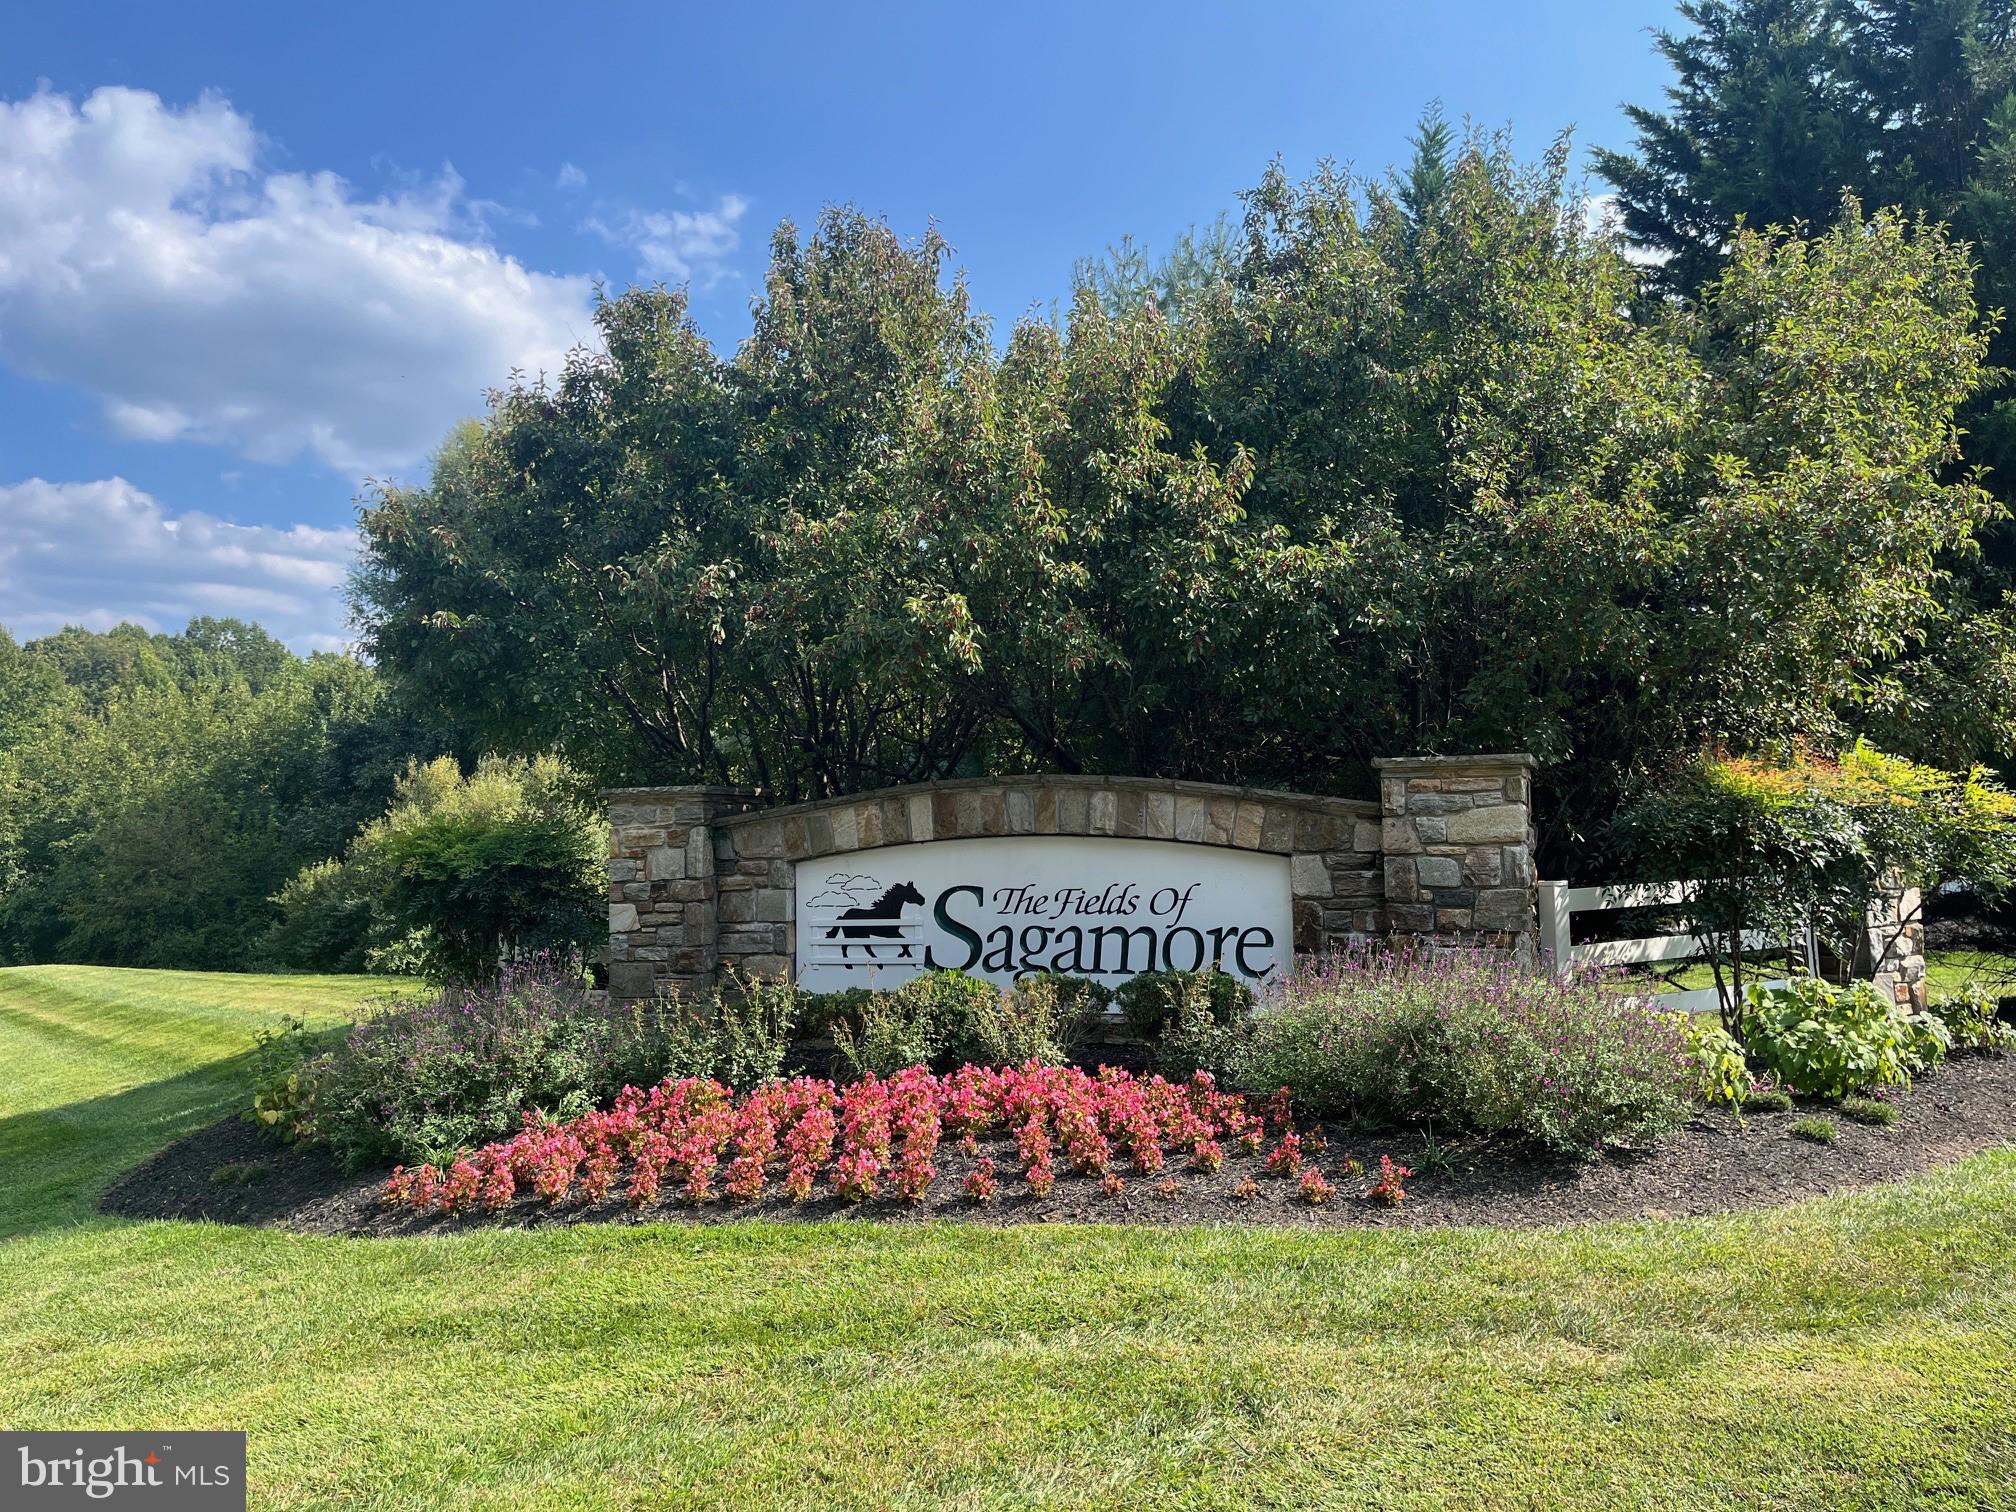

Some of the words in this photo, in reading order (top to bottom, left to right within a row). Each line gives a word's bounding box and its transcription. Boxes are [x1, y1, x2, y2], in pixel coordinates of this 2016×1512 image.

[924, 885, 1276, 985] Sagamore
[992, 883, 1048, 915] The
[1048, 883, 1140, 920] Fields
[1149, 883, 1202, 929] Of
